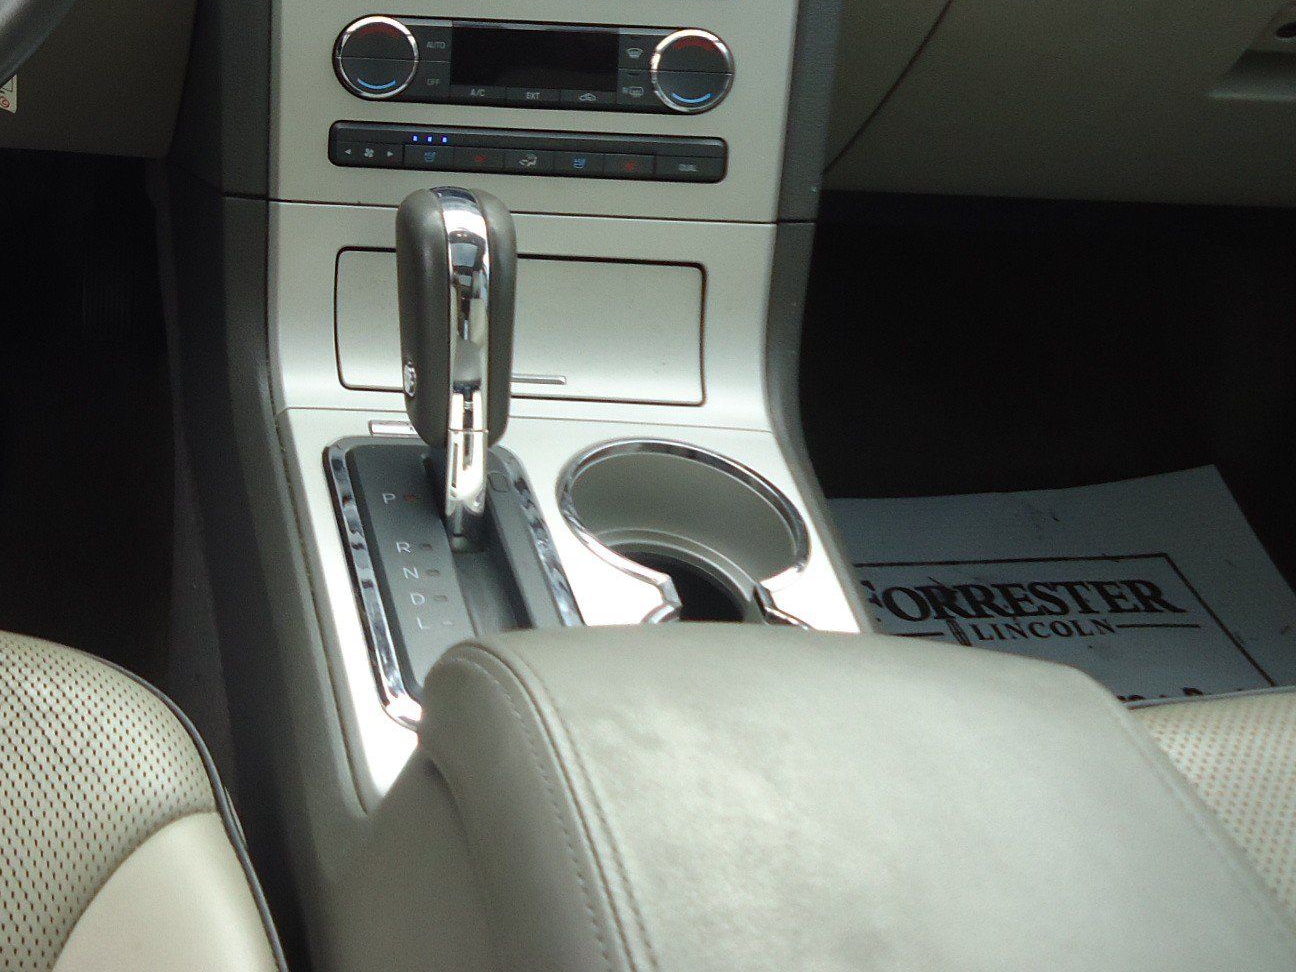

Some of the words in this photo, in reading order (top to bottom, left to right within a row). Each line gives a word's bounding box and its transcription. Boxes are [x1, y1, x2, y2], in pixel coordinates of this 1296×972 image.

[426, 41, 446, 50] AUTO
[426, 78, 440, 86] OFF
[470, 88, 486, 97] A/C
[526, 92, 541, 100] EXT
[382, 493, 397, 505] P
[396, 541, 412, 554] R
[403, 566, 419, 579] N
[410, 592, 426, 606] D
[417, 617, 429, 630] L
[968, 616, 1117, 642] LINCOLN
